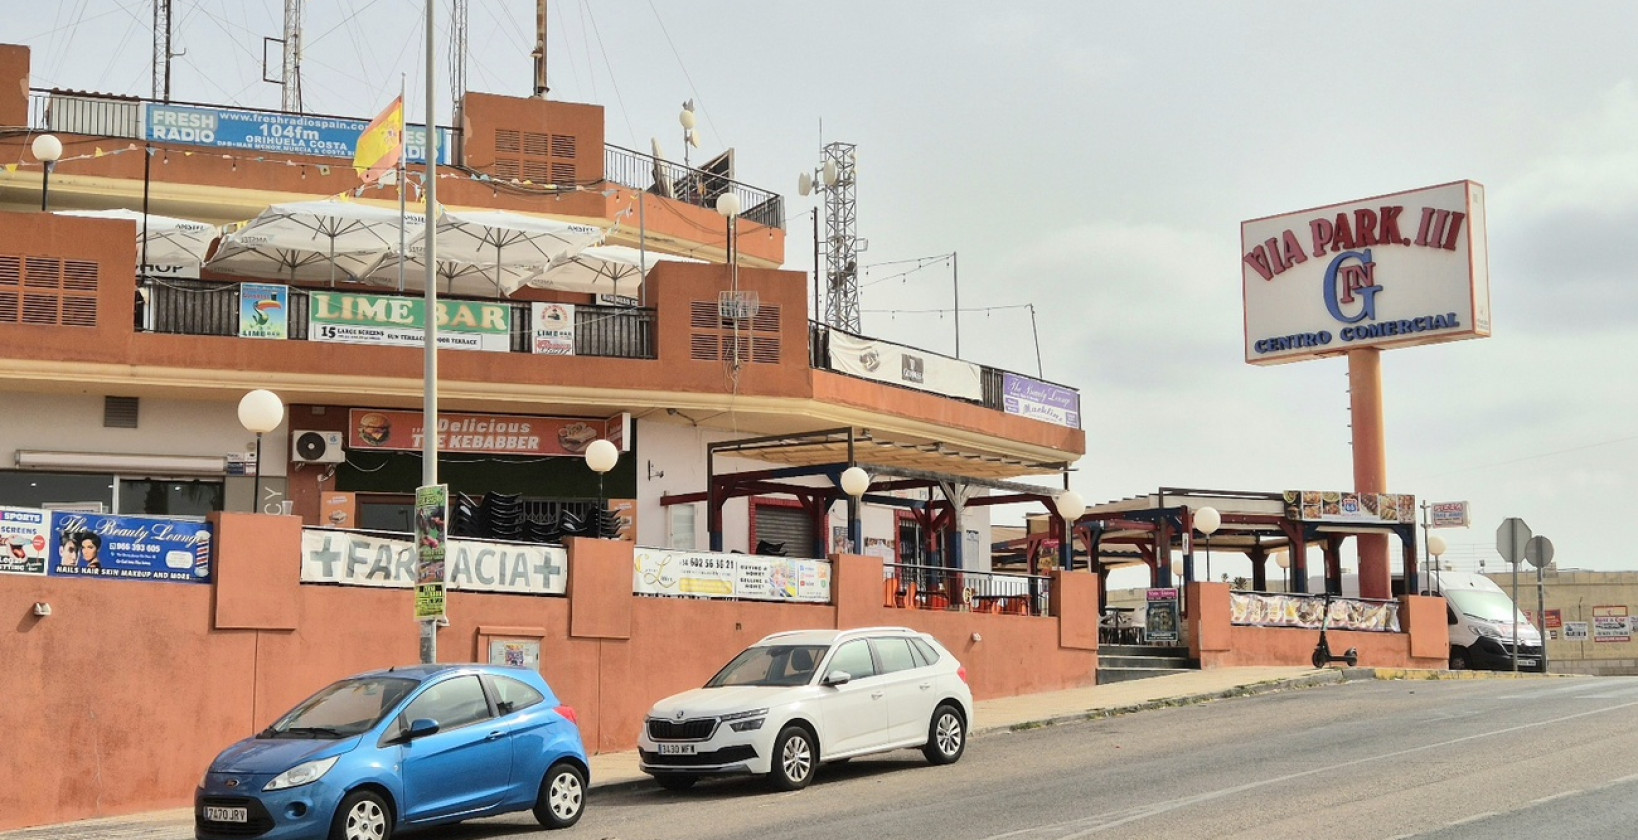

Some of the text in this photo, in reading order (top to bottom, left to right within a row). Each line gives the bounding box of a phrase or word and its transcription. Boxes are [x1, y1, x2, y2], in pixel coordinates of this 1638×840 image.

[153, 110, 214, 129] FRESH
[153, 125, 215, 143] RADIO
[260, 123, 319, 140] 104fm
[245, 135, 348, 151] ORIHUELA COSTA
[1415, 207, 1465, 251] III
[1244, 229, 1308, 281] VIA
[1322, 248, 1383, 324] G
[315, 294, 414, 324] LIME
[436, 303, 507, 330] BAR
[321, 326, 336, 339] 15
[1254, 330, 1332, 354] CENTRO
[1340, 312, 1460, 343] COMERCIAL
[437, 418, 531, 433] Delicious
[412, 434, 539, 449] TE KEBABBER
[56, 514, 88, 532] The
[95, 519, 149, 543] Beauty
[56, 566, 79, 574] NAILS
[346, 539, 530, 587] FARACIA
[208, 808, 229, 820] 7470
